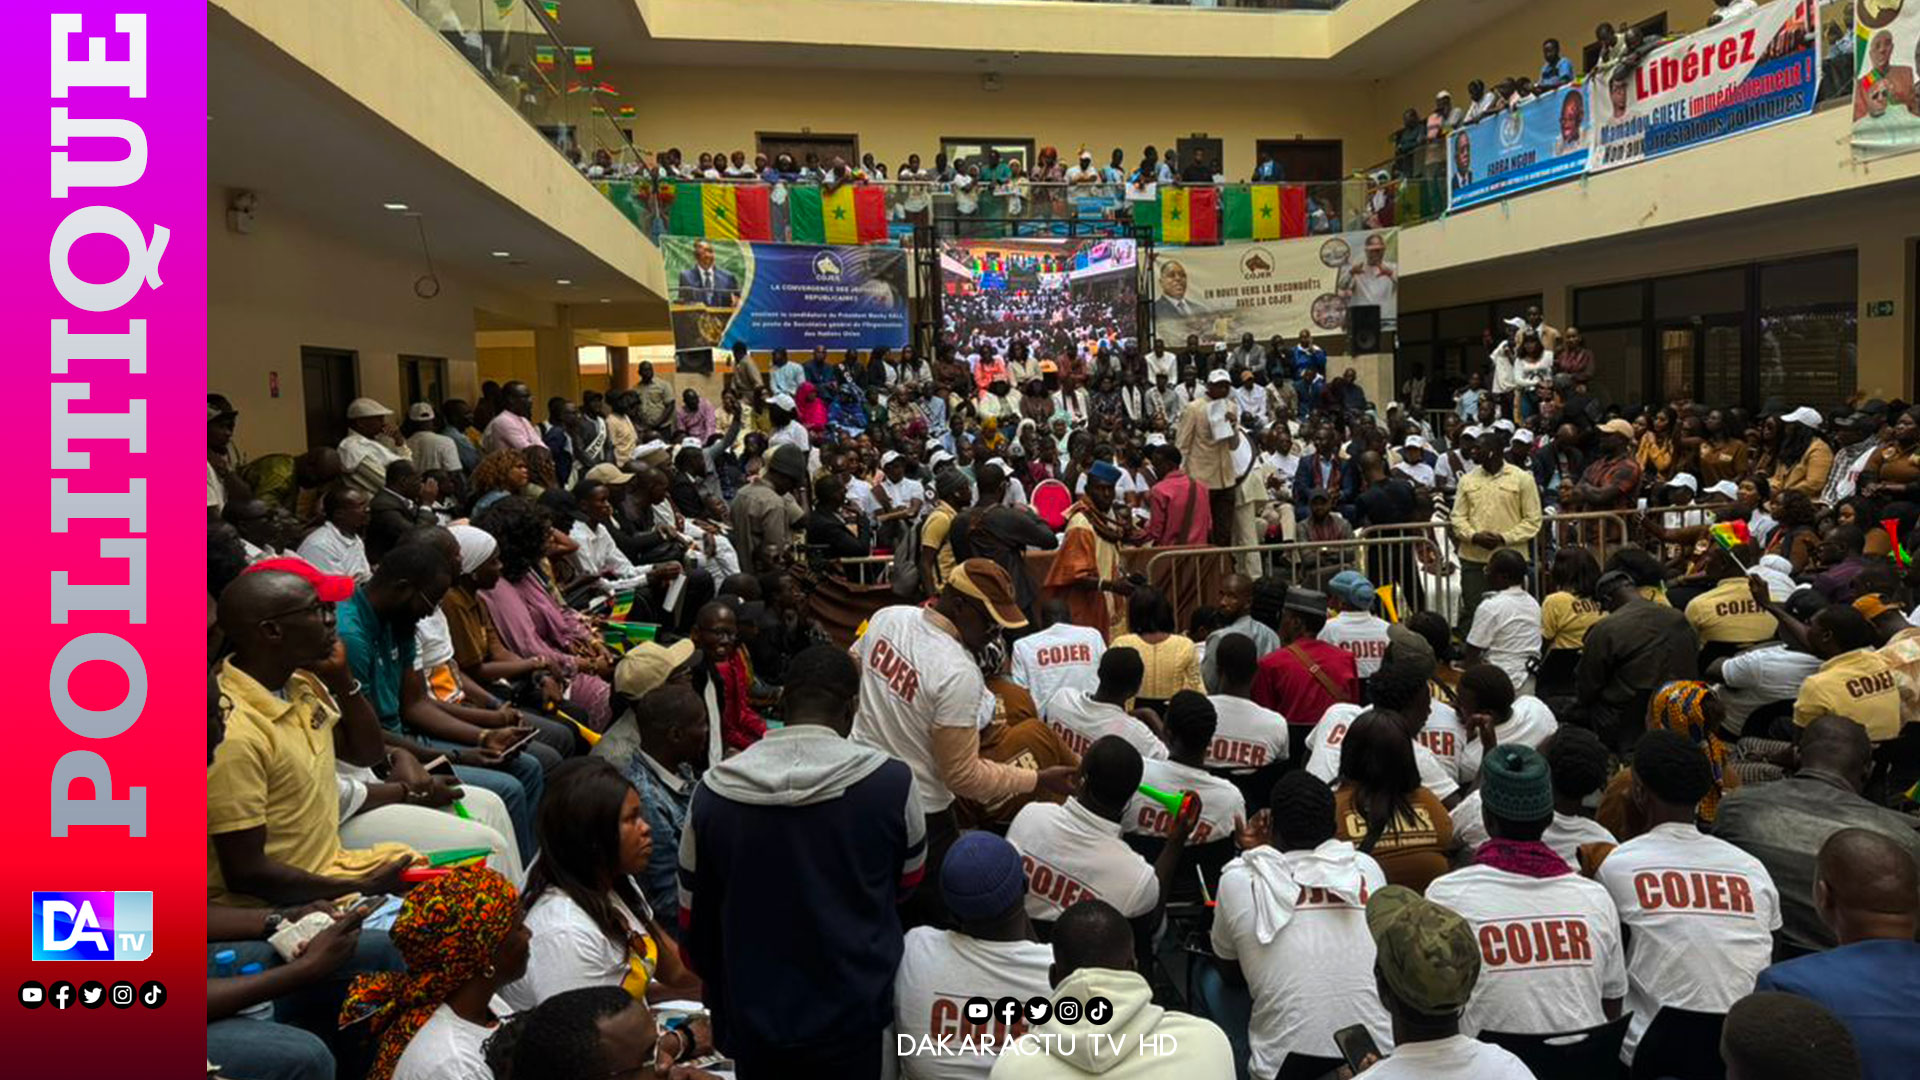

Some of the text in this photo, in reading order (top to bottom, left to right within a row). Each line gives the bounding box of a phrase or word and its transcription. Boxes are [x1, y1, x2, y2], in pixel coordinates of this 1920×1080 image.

[1635, 28, 1758, 100] Libérez
[1652, 98, 1686, 124] GUEYE
[1244, 271, 1272, 280] COJER
[782, 284, 834, 292] CONVERGENCE
[1204, 289, 1214, 299] EN
[1216, 287, 1239, 298] ROUTE
[1241, 285, 1260, 296] VERS
[1261, 284, 1272, 294] LA
[1236, 294, 1292, 308] AVEC LA COJER
[1036, 644, 1092, 667] COJER
[1633, 870, 1755, 914] COJER
[1478, 919, 1592, 967] COJER
